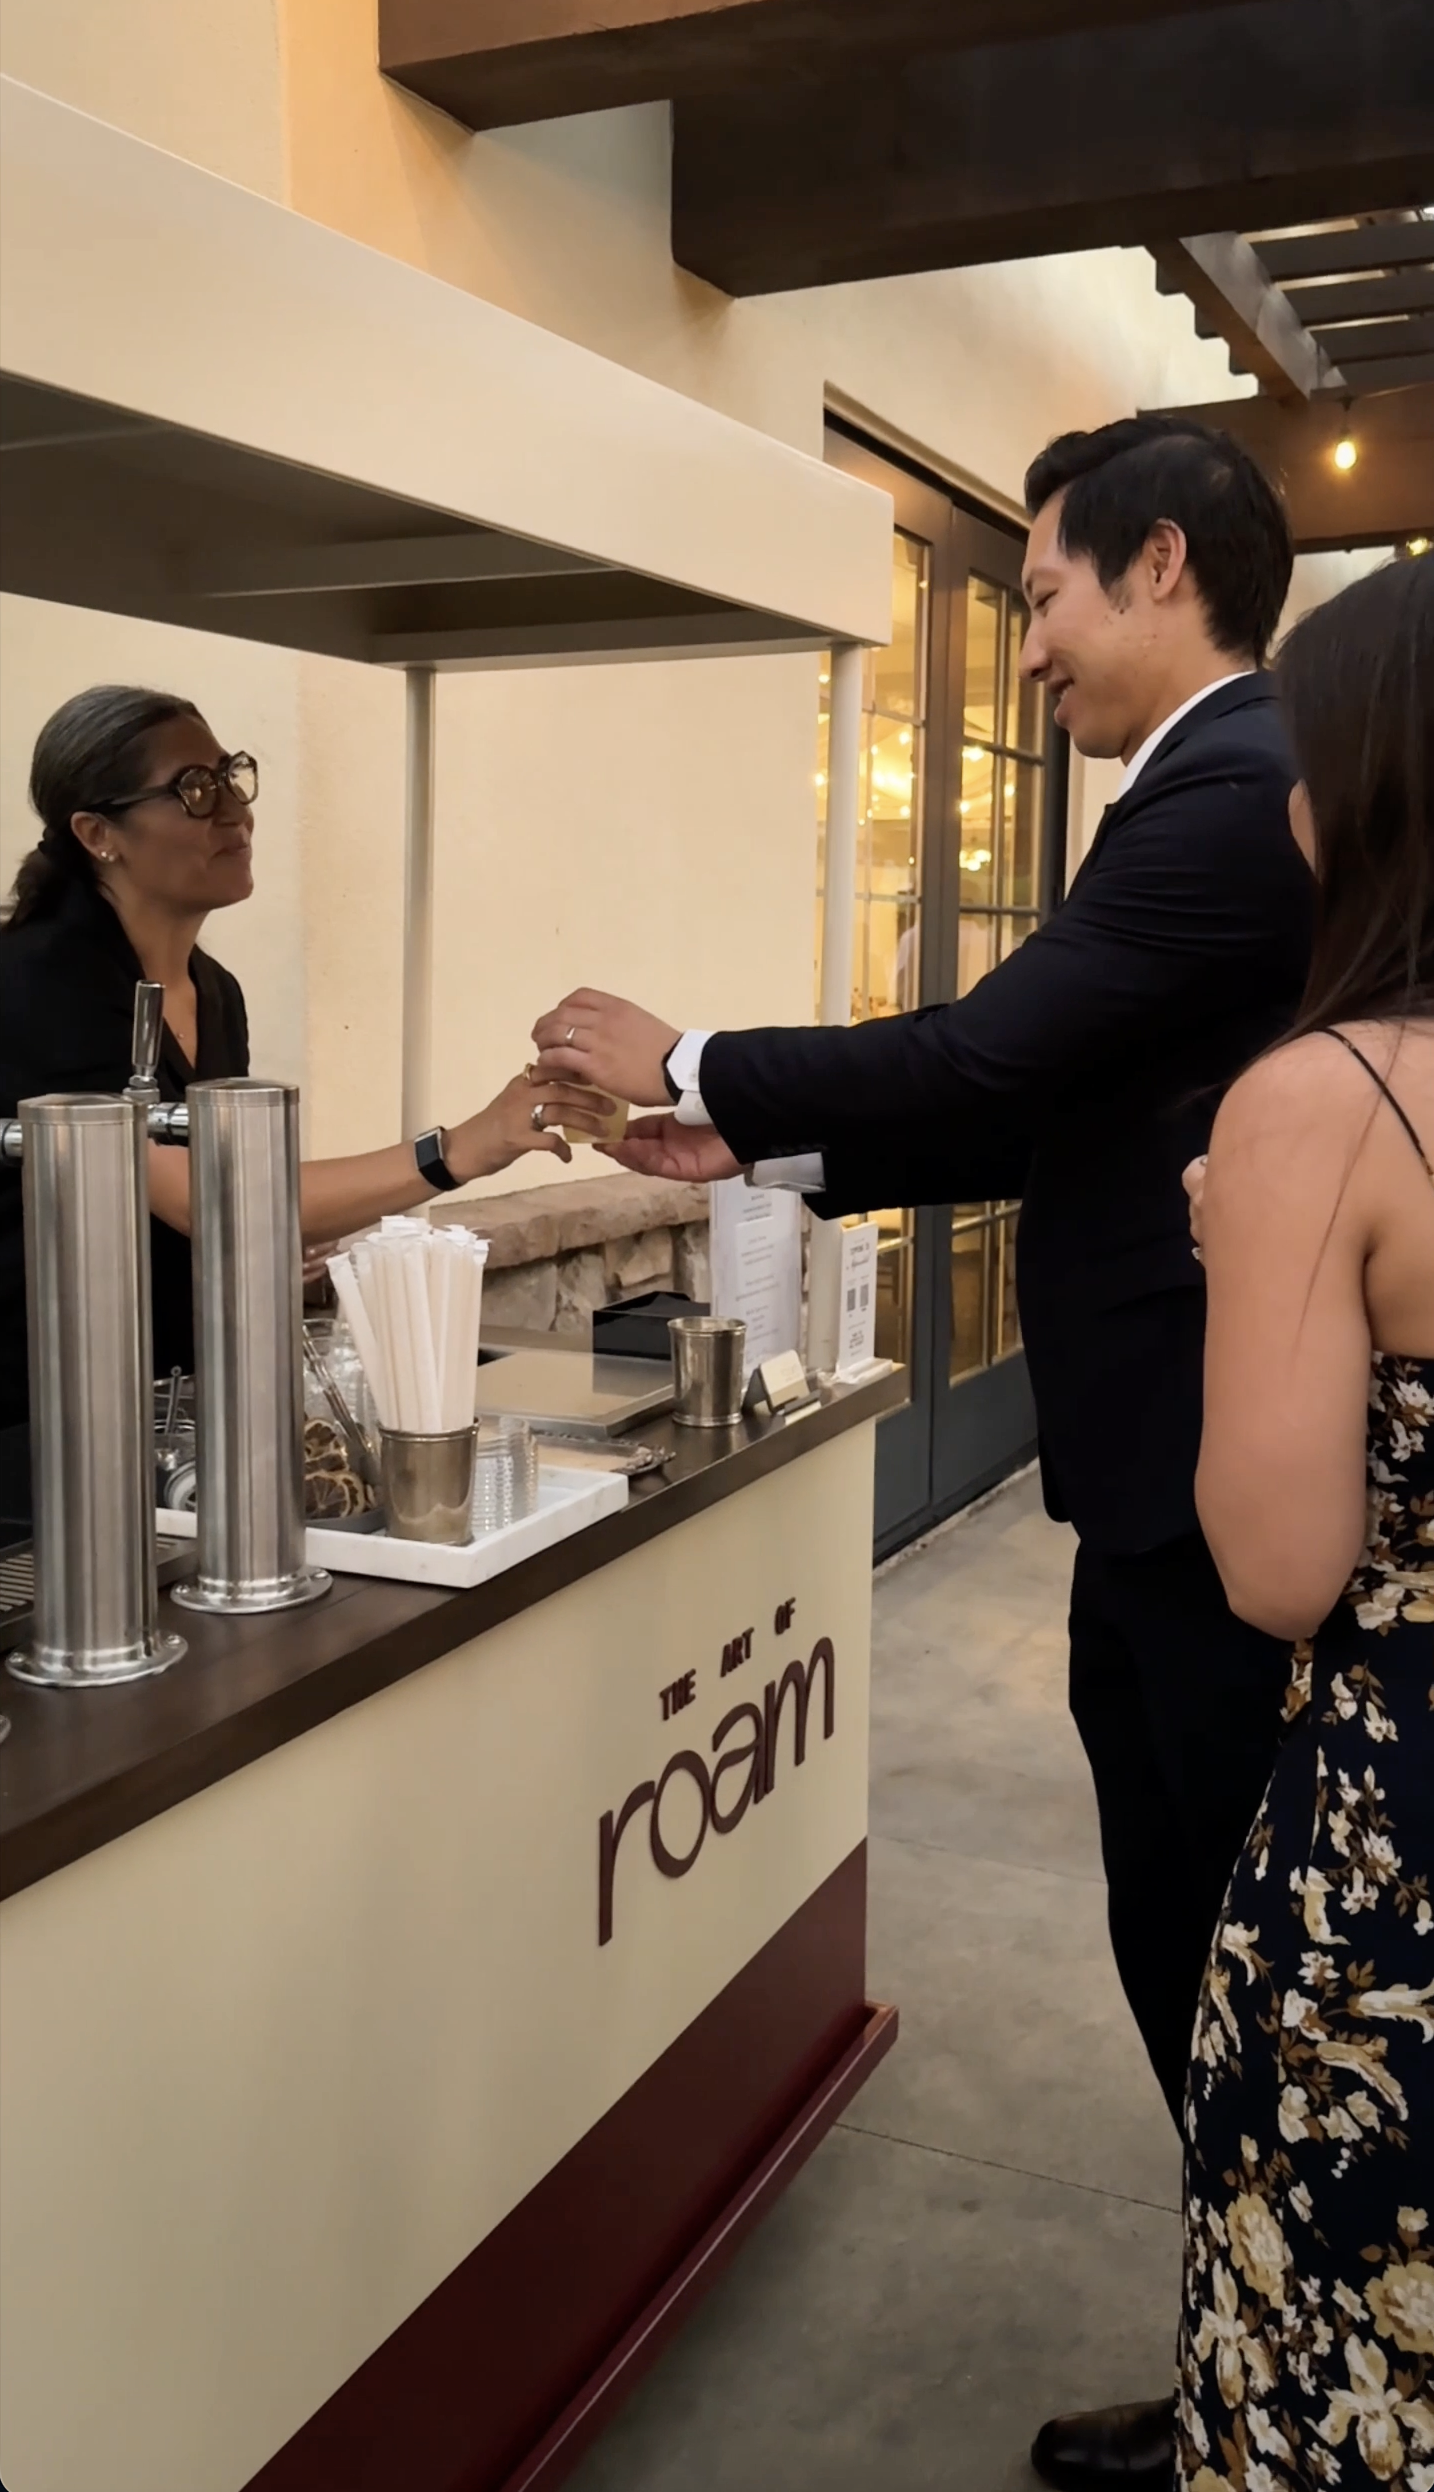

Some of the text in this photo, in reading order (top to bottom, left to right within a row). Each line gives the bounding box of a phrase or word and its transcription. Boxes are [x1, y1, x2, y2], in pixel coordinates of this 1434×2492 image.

[659, 1597, 797, 1722] THE ART OF
[598, 1636, 836, 1947] roam
